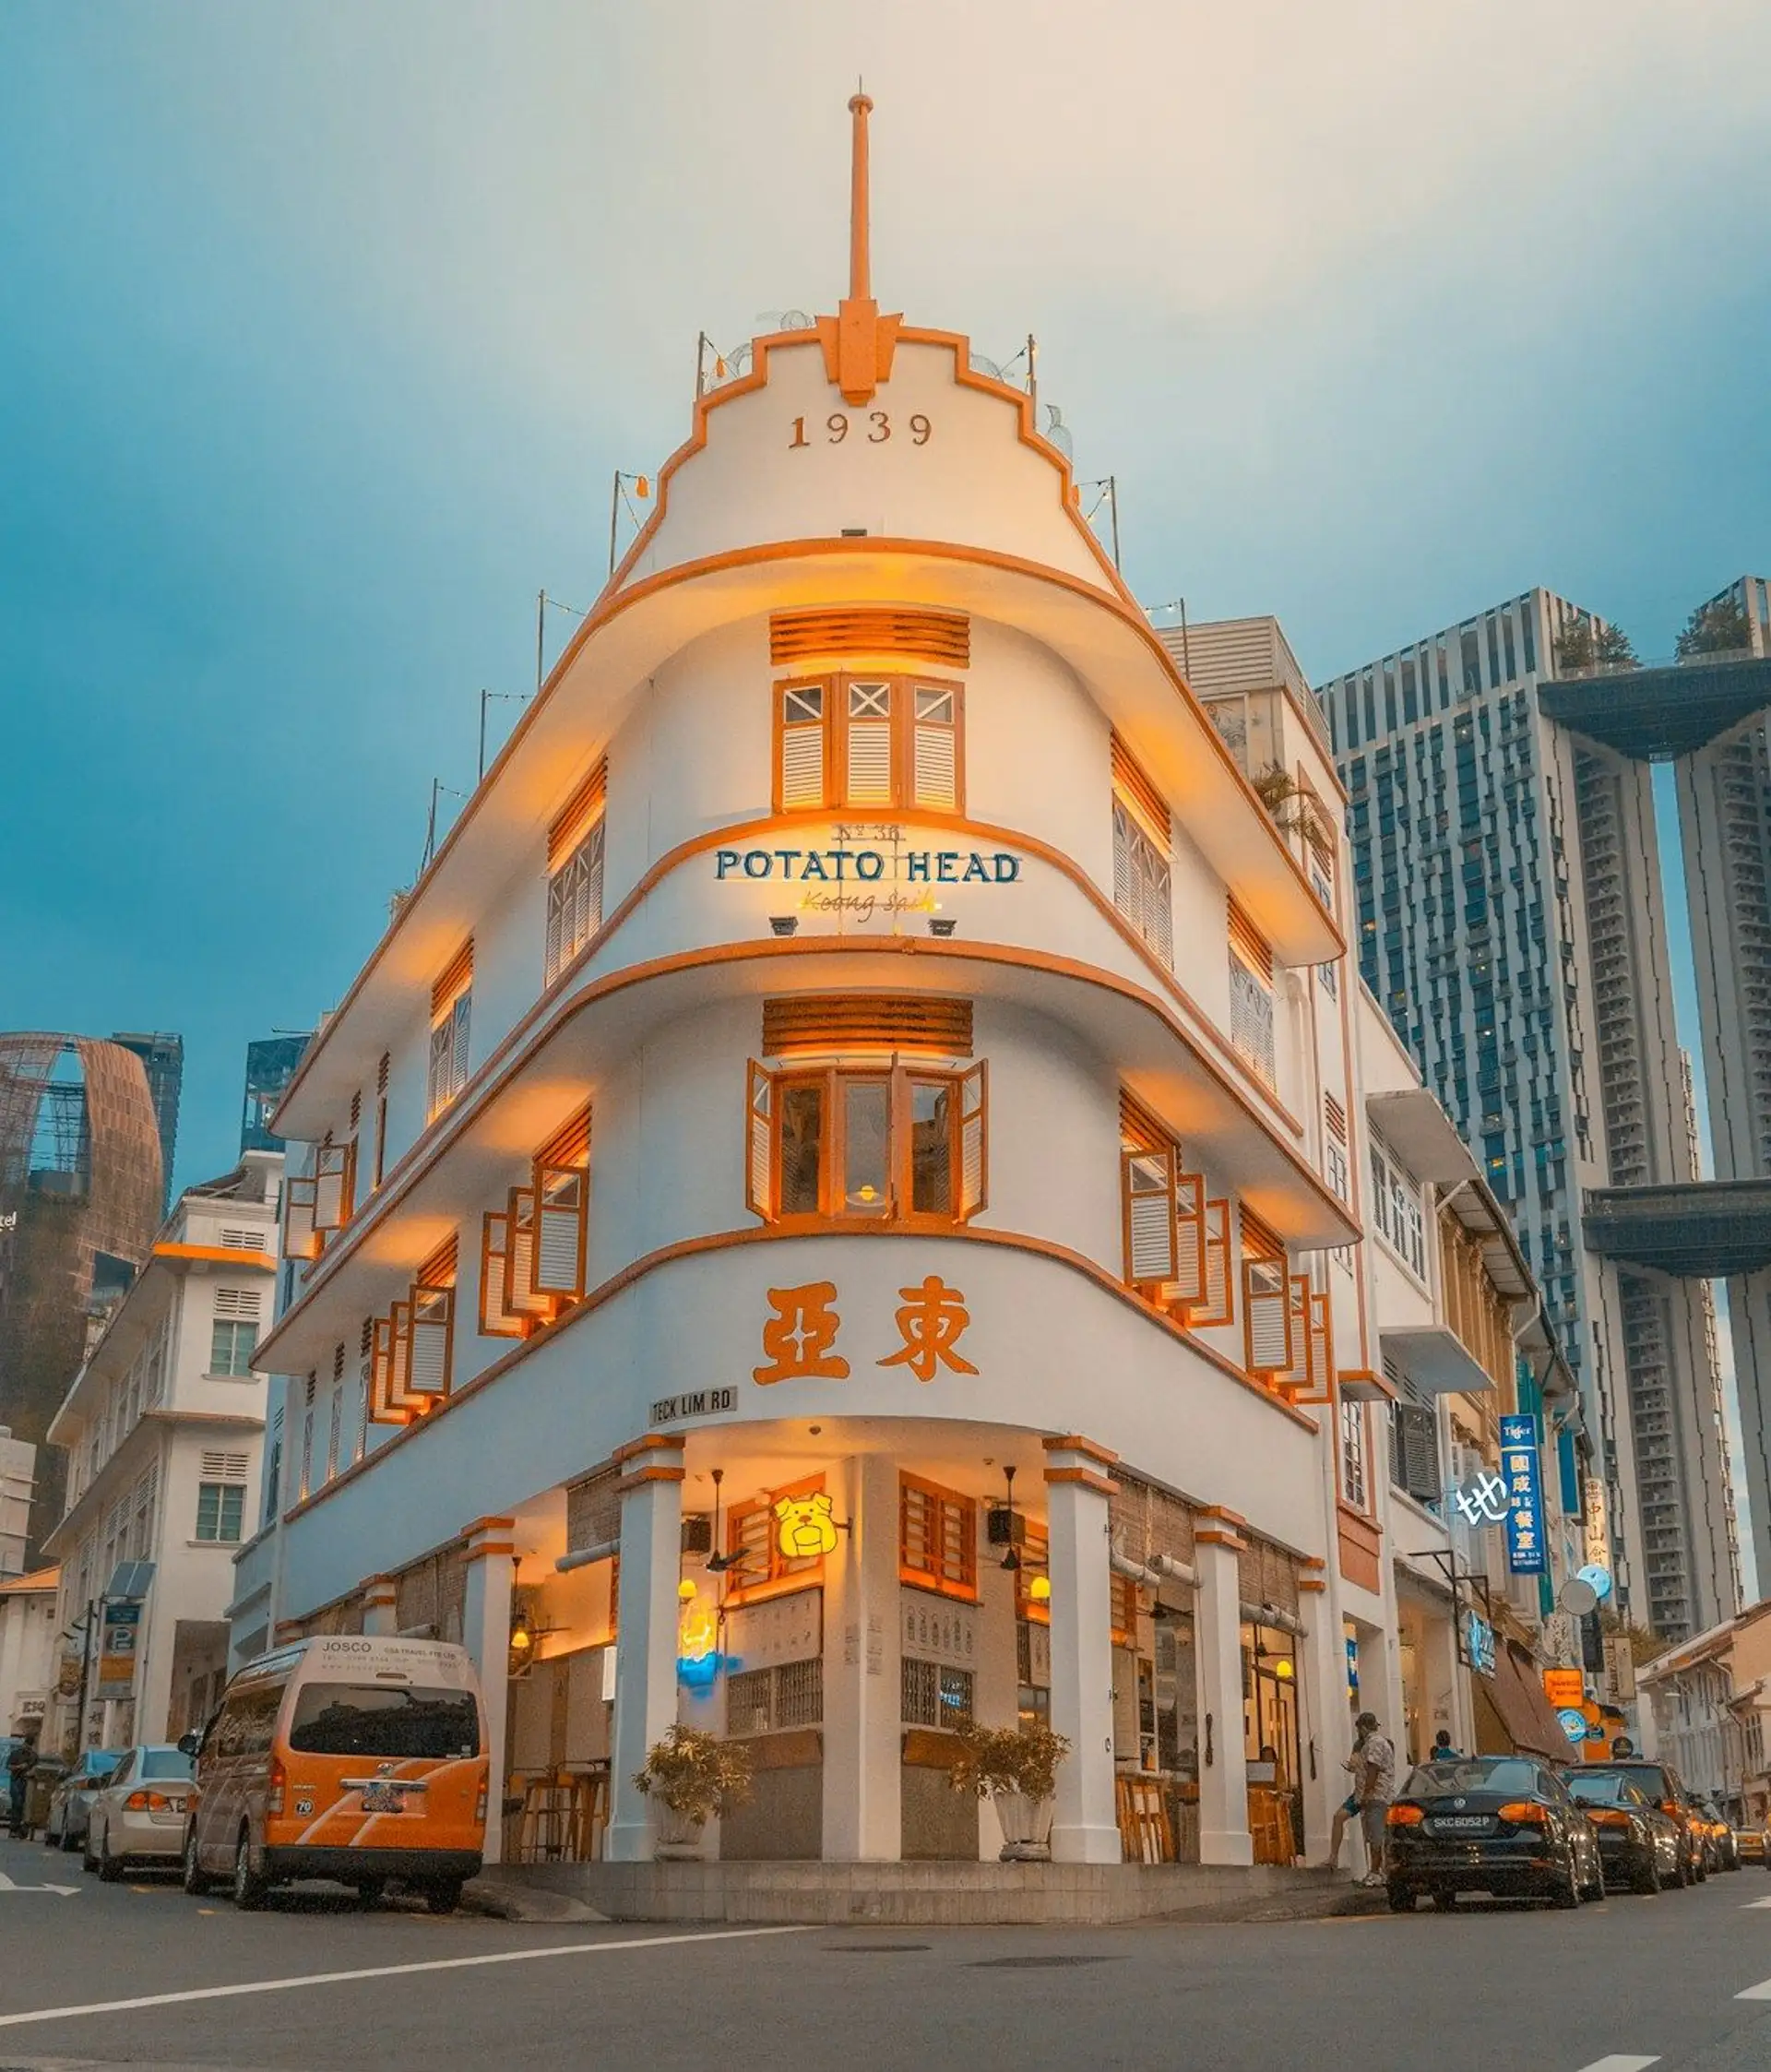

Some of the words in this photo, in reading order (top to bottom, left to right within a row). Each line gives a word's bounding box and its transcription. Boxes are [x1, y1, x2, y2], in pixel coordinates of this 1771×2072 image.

[789, 411, 932, 449] 1939
[715, 850, 885, 881] POTATO
[906, 851, 1020, 883] HEAD
[801, 890, 875, 923] Keong
[653, 1399, 676, 1423] TECK
[682, 1393, 705, 1416] LIM
[711, 1388, 731, 1411] RD
[1504, 1424, 1532, 1439] Tiger
[322, 1642, 372, 1653] JOSCO
